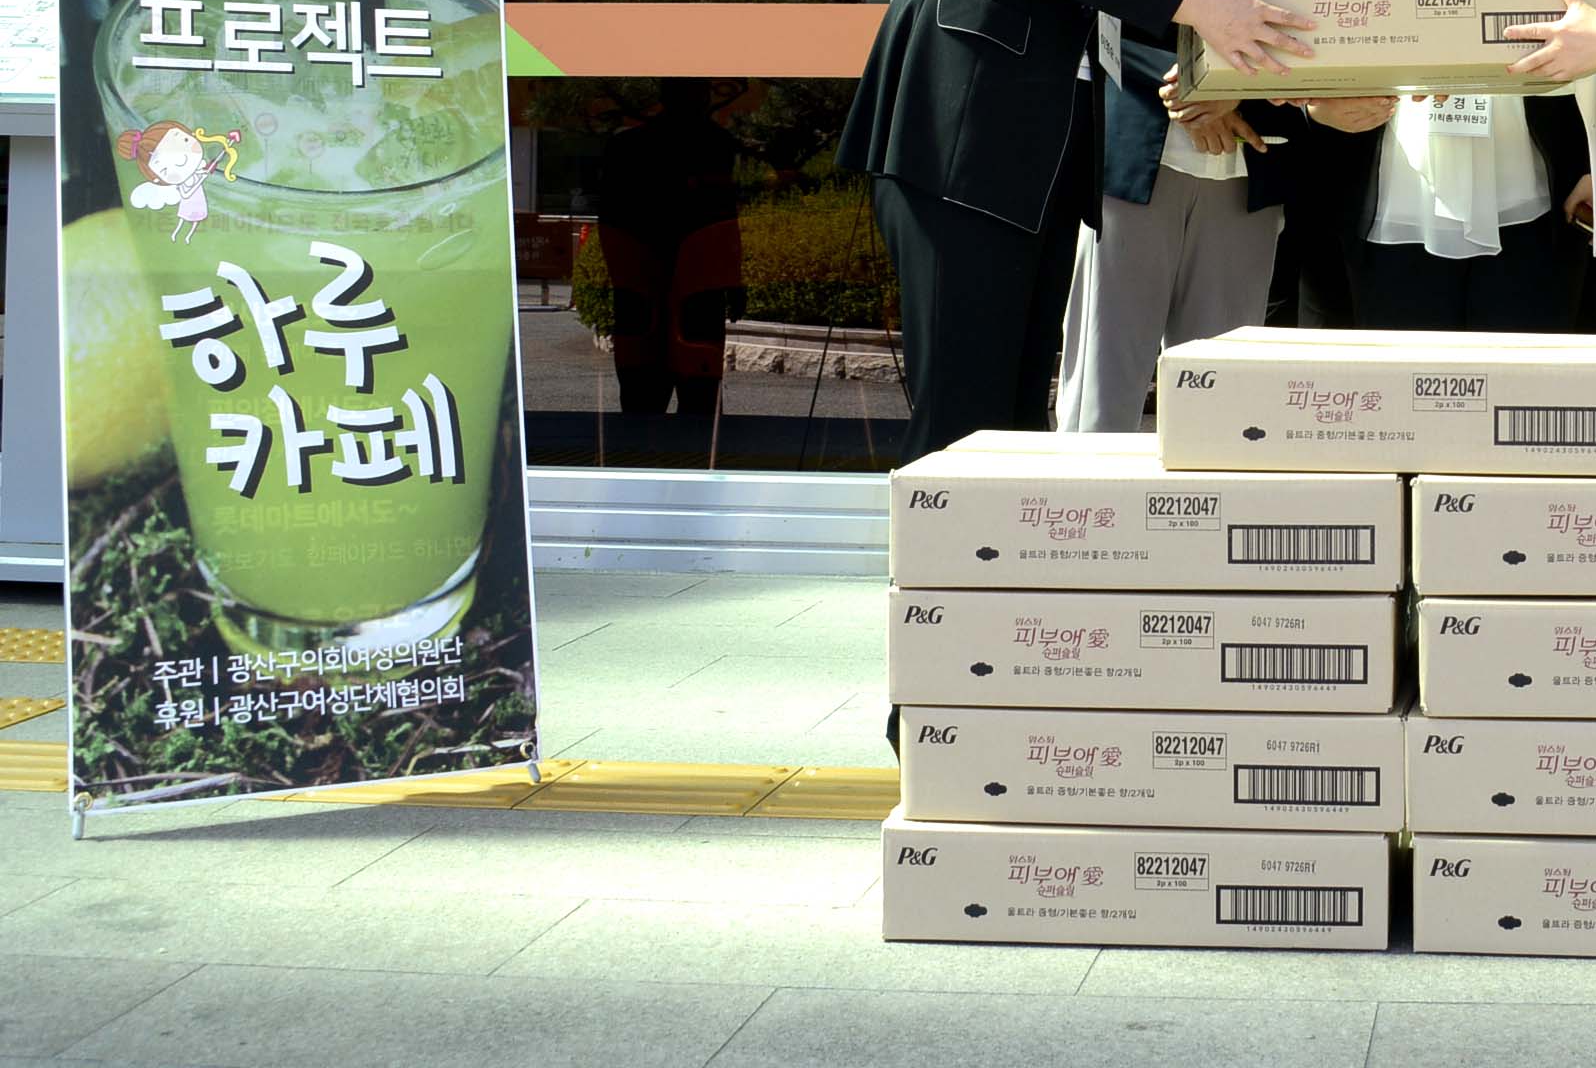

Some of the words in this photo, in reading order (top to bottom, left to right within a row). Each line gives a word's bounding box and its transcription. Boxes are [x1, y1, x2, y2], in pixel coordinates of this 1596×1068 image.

[1312, 0, 1372, 20] 피부애
[158, 241, 409, 395] 하루
[1176, 370, 1217, 390] P&G
[1415, 377, 1485, 398] 82212047
[1285, 389, 1358, 412] 피부애
[205, 372, 467, 500] 카페
[909, 490, 950, 510] P&G
[1148, 496, 1218, 517] 82212047
[1434, 493, 1475, 513] P&G
[1018, 506, 1091, 529] 피부애
[904, 605, 945, 625] P&G
[1142, 614, 1212, 635] 82212047
[1440, 616, 1481, 636] P&G
[1012, 626, 1085, 649] 피부애
[152, 656, 205, 689] 주관
[226, 635, 465, 686] 광산구의회여성의원단
[152, 698, 206, 730] 후원
[227, 673, 466, 723] 광산구여성단체협의회
[918, 725, 959, 745] P&G
[1154, 735, 1224, 756] 82212047
[1424, 735, 1465, 755] P&G
[1025, 744, 1098, 767] 피부애
[897, 847, 938, 867] P&G
[1136, 856, 1206, 877] 82212047
[1006, 864, 1079, 887] 피부애
[1430, 858, 1471, 878] P&G
